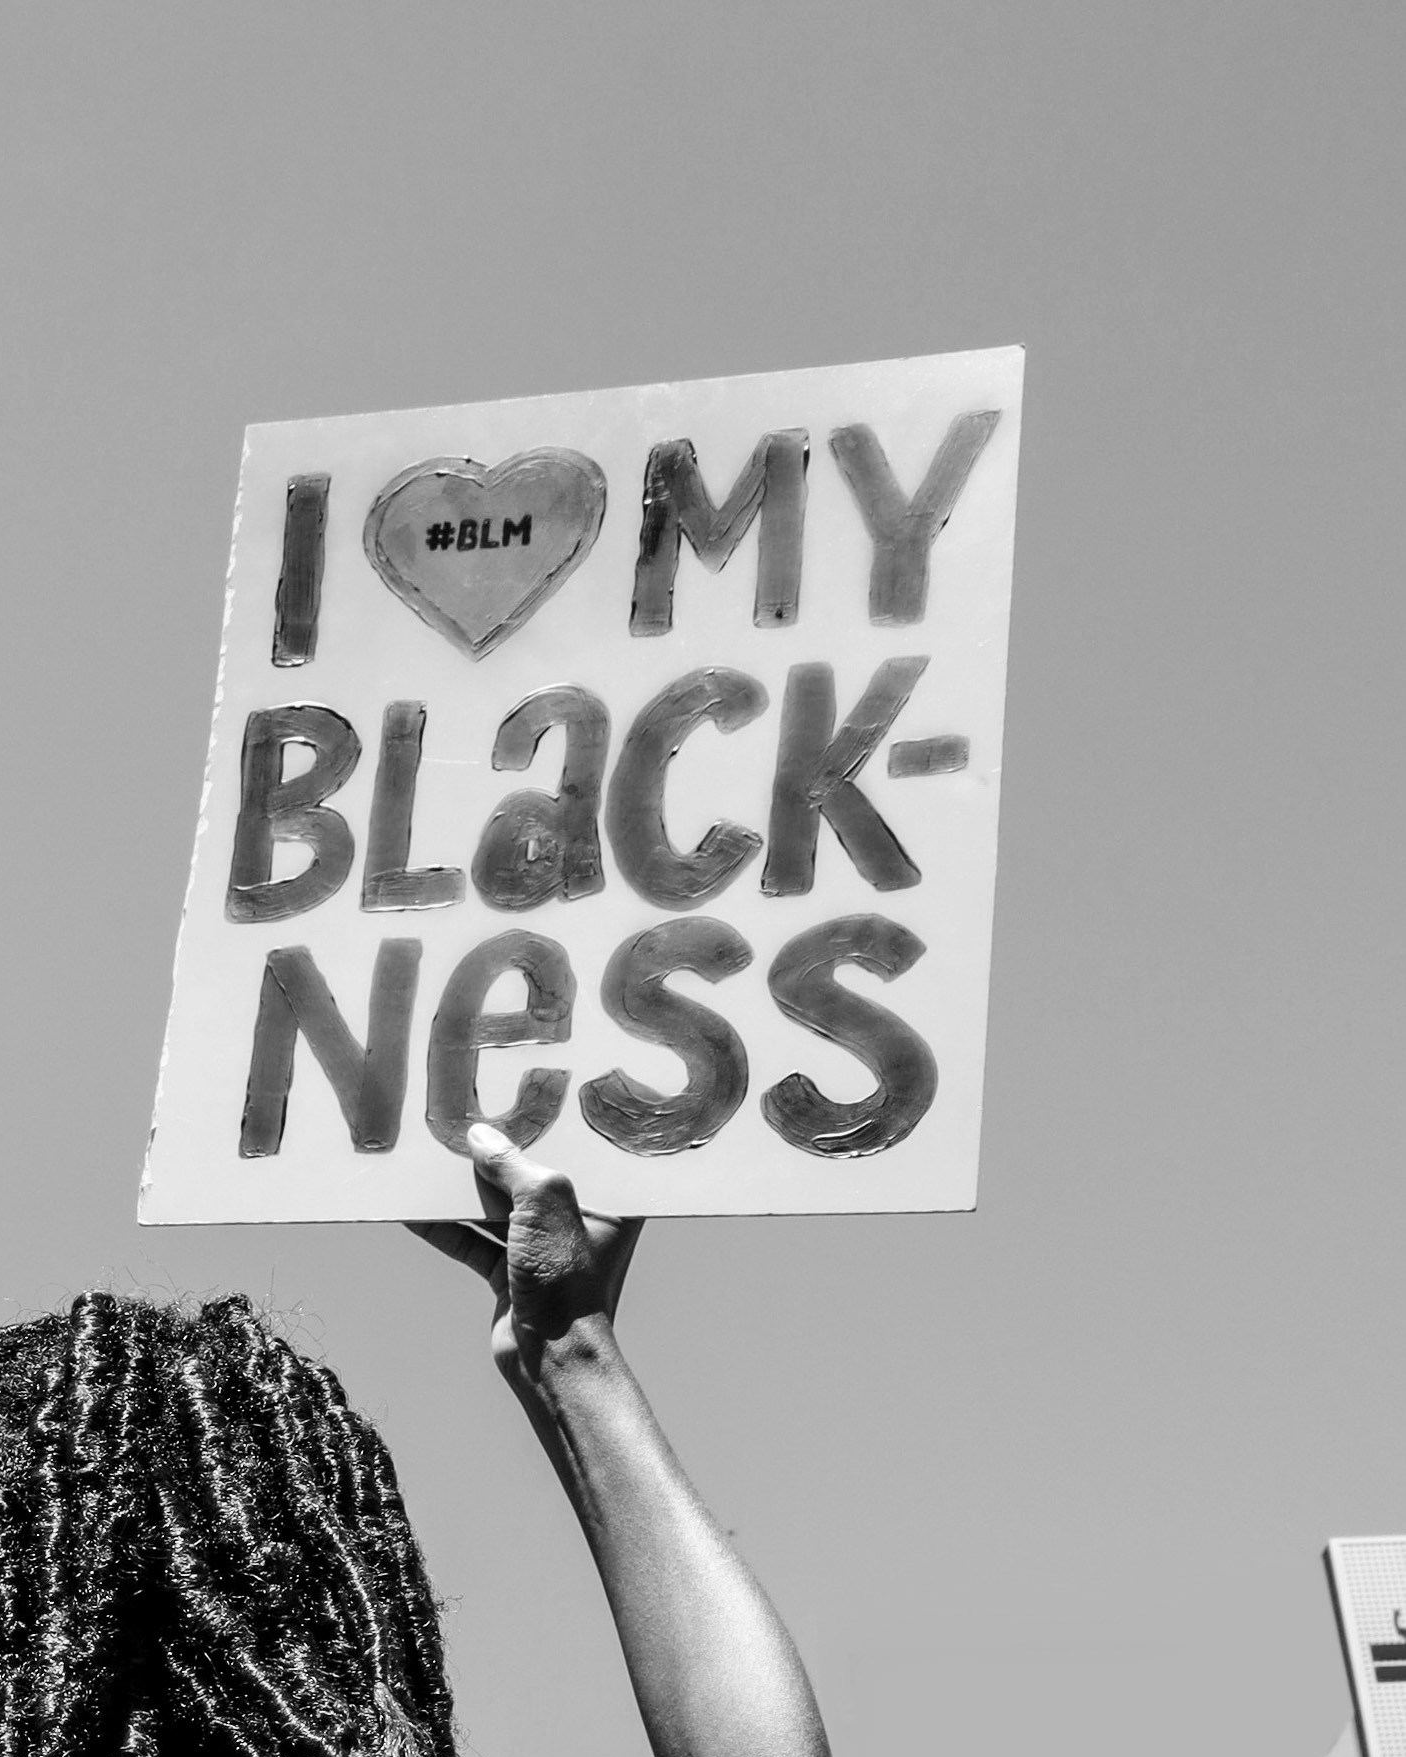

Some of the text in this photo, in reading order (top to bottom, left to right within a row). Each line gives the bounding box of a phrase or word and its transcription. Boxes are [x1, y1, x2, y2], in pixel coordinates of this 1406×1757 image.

[272, 409, 1002, 667] I MY
[425, 514, 533, 552] #BLM
